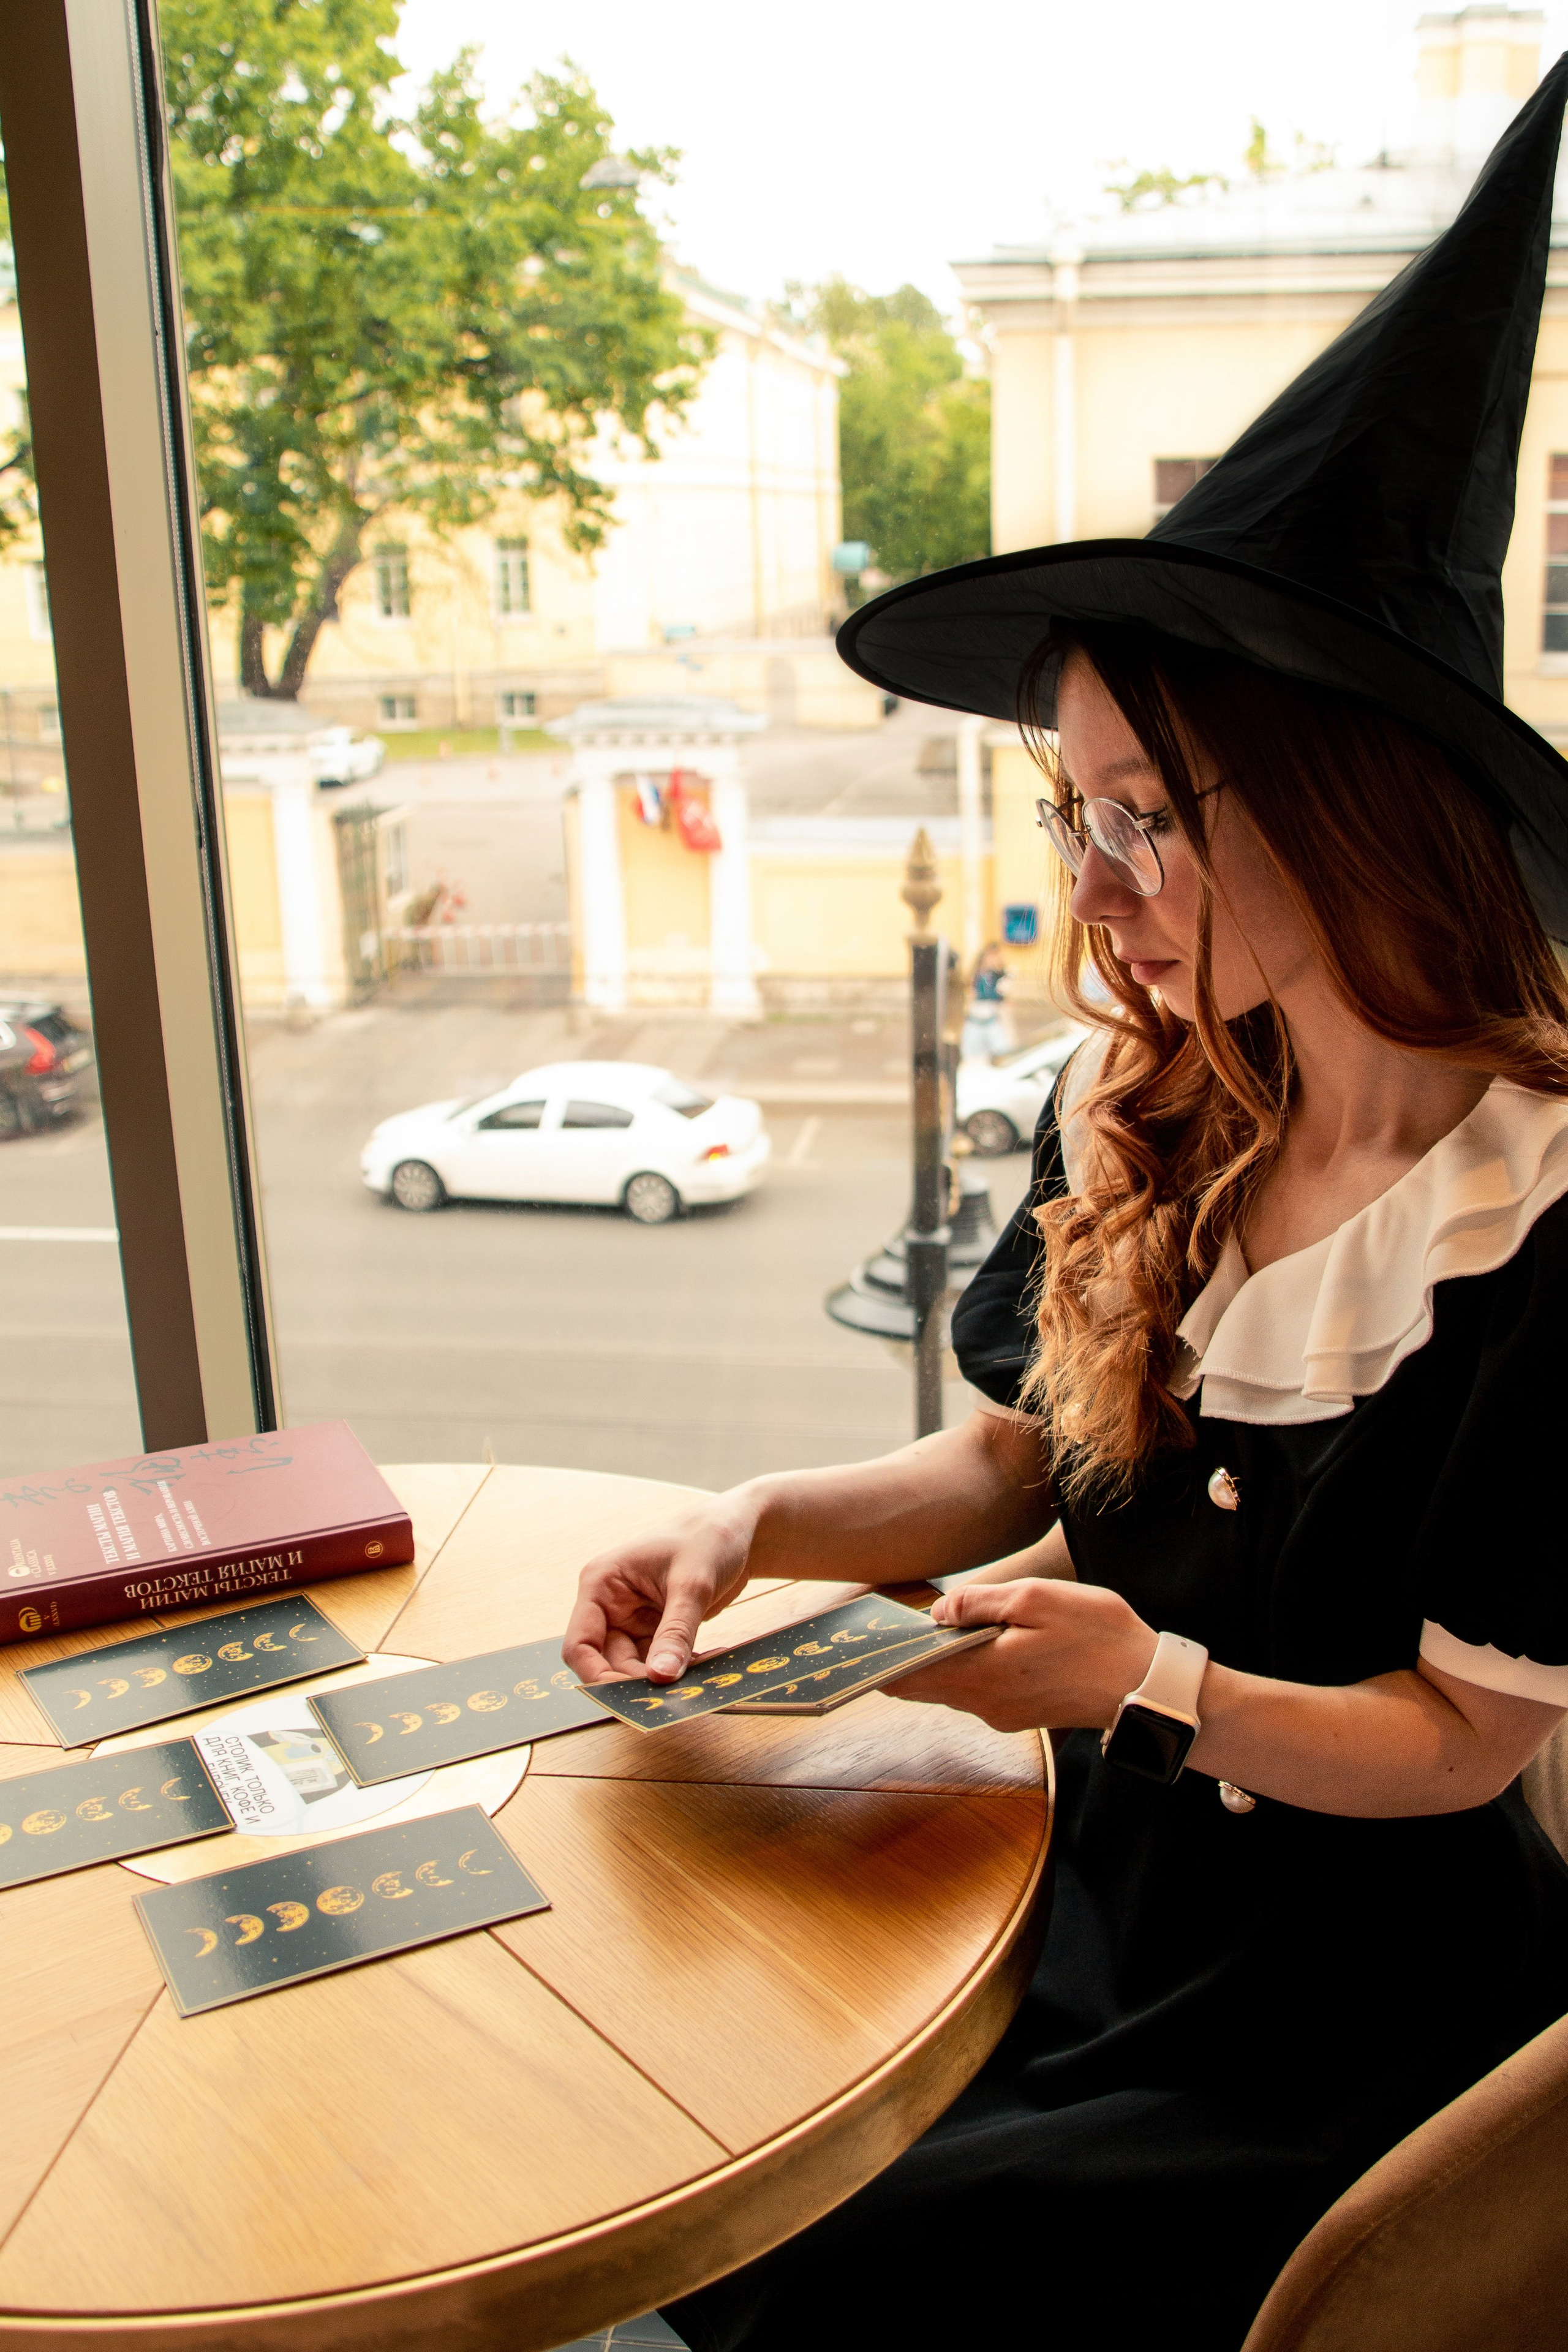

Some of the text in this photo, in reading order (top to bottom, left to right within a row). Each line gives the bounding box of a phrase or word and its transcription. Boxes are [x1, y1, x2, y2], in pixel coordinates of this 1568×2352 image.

[103, 1490, 127, 1525] ТЕКСТОВ
[86, 1503, 119, 1564] ТЕКСТЫ МАГИИ
[115, 1525, 138, 1553] МАГИЯ
[159, 1528, 178, 1552] КАРТИНА
[171, 1513, 194, 1549] СЛОВЕСНОСТЬ
[187, 1514, 211, 1546] ВОСТОЧНОЙ
[124, 1550, 303, 1599] И МАГИЯ ТЕКСТОВ
[140, 1569, 292, 1609] ТЕКСТЫ МАГИИ
[202, 1736, 227, 1757] ДЛЯ
[216, 1758, 241, 1785] КНИГ,
[230, 1785, 256, 1814] КОФЕ
[244, 1815, 261, 1825] И
[225, 1736, 275, 1814] СТОЛИК ТОЛЬКО
